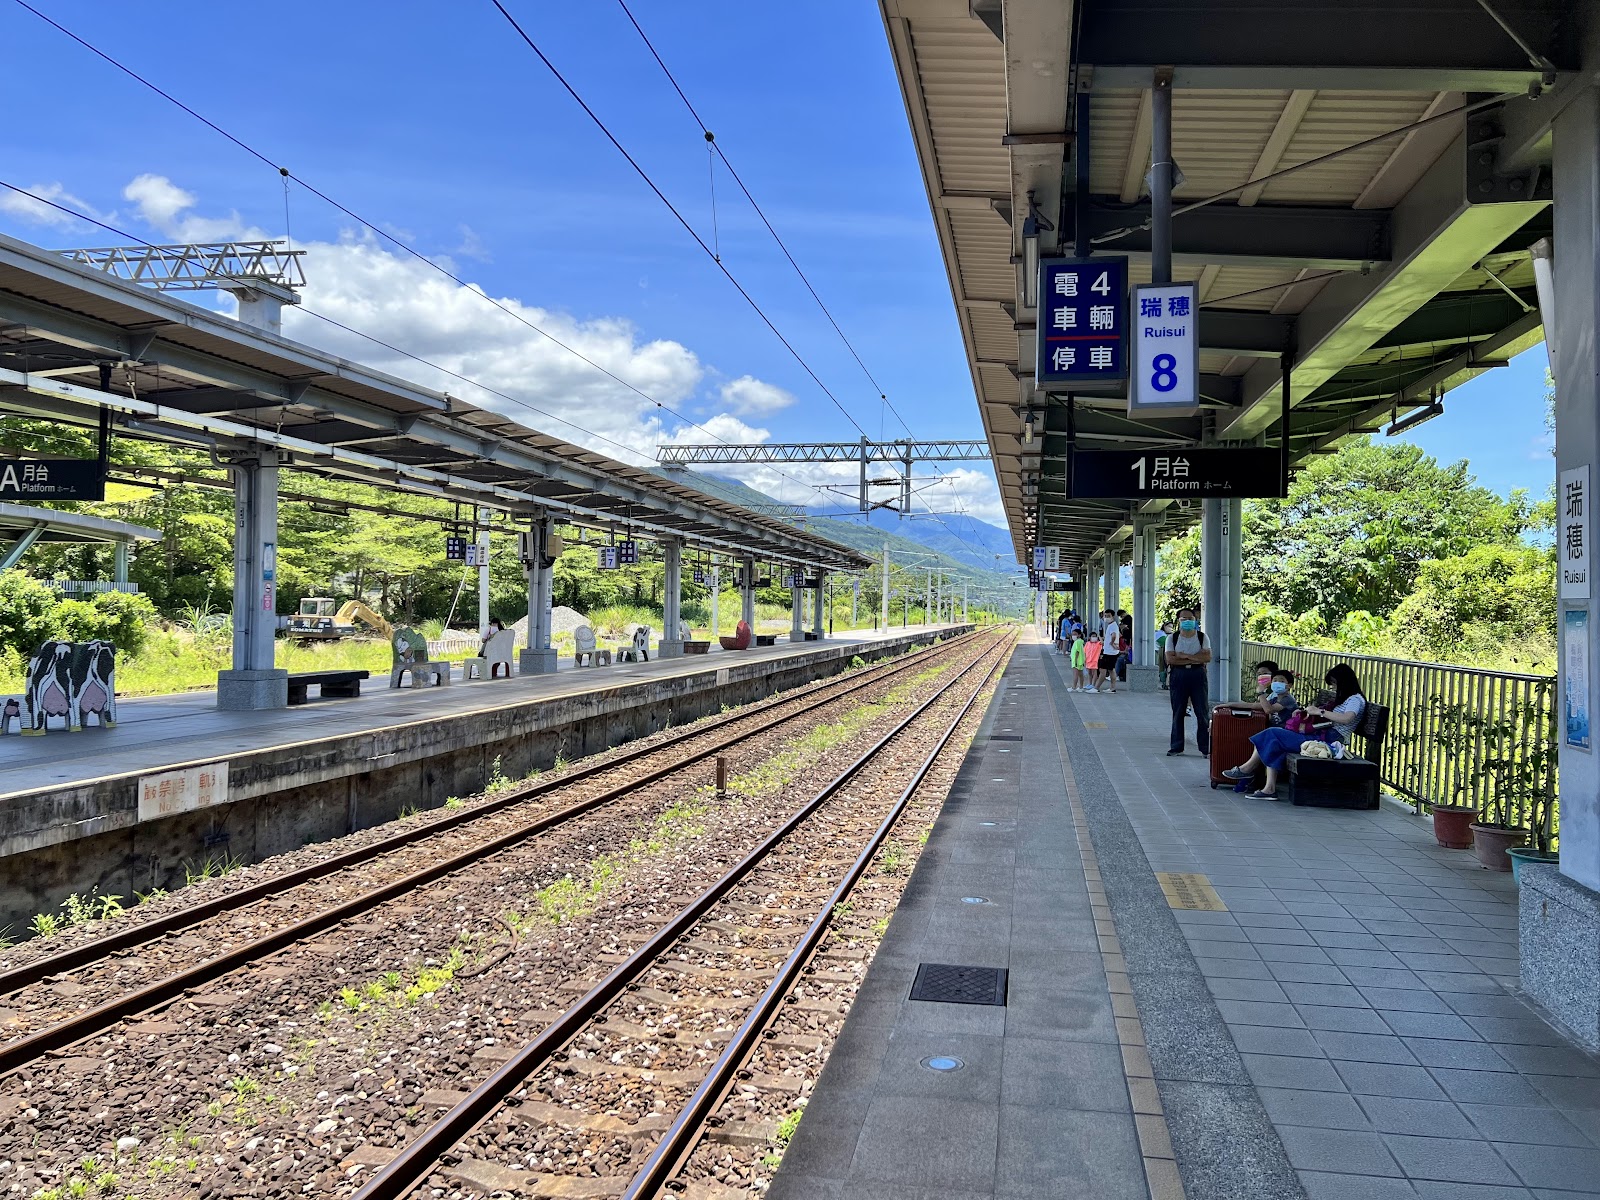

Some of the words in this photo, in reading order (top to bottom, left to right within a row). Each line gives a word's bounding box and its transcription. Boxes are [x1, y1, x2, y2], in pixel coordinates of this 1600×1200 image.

[1144, 326, 1186, 338] Ruisui
[1052, 346, 1113, 371] 停車
[1151, 353, 1178, 393] 8
[22, 463, 49, 482] 月台
[1131, 456, 1146, 490] 1
[1152, 456, 1191, 477] 月台
[0, 464, 21, 492] A
[1151, 479, 1200, 490] Platform
[1203, 480, 1232, 490] ホーム
[21, 483, 56, 493] Platform
[57, 485, 77, 493] ホーム
[608, 558, 613, 566] 7
[1037, 560, 1042, 568] 7
[1564, 569, 1586, 584] Ruisui
[159, 802, 171, 813] No
